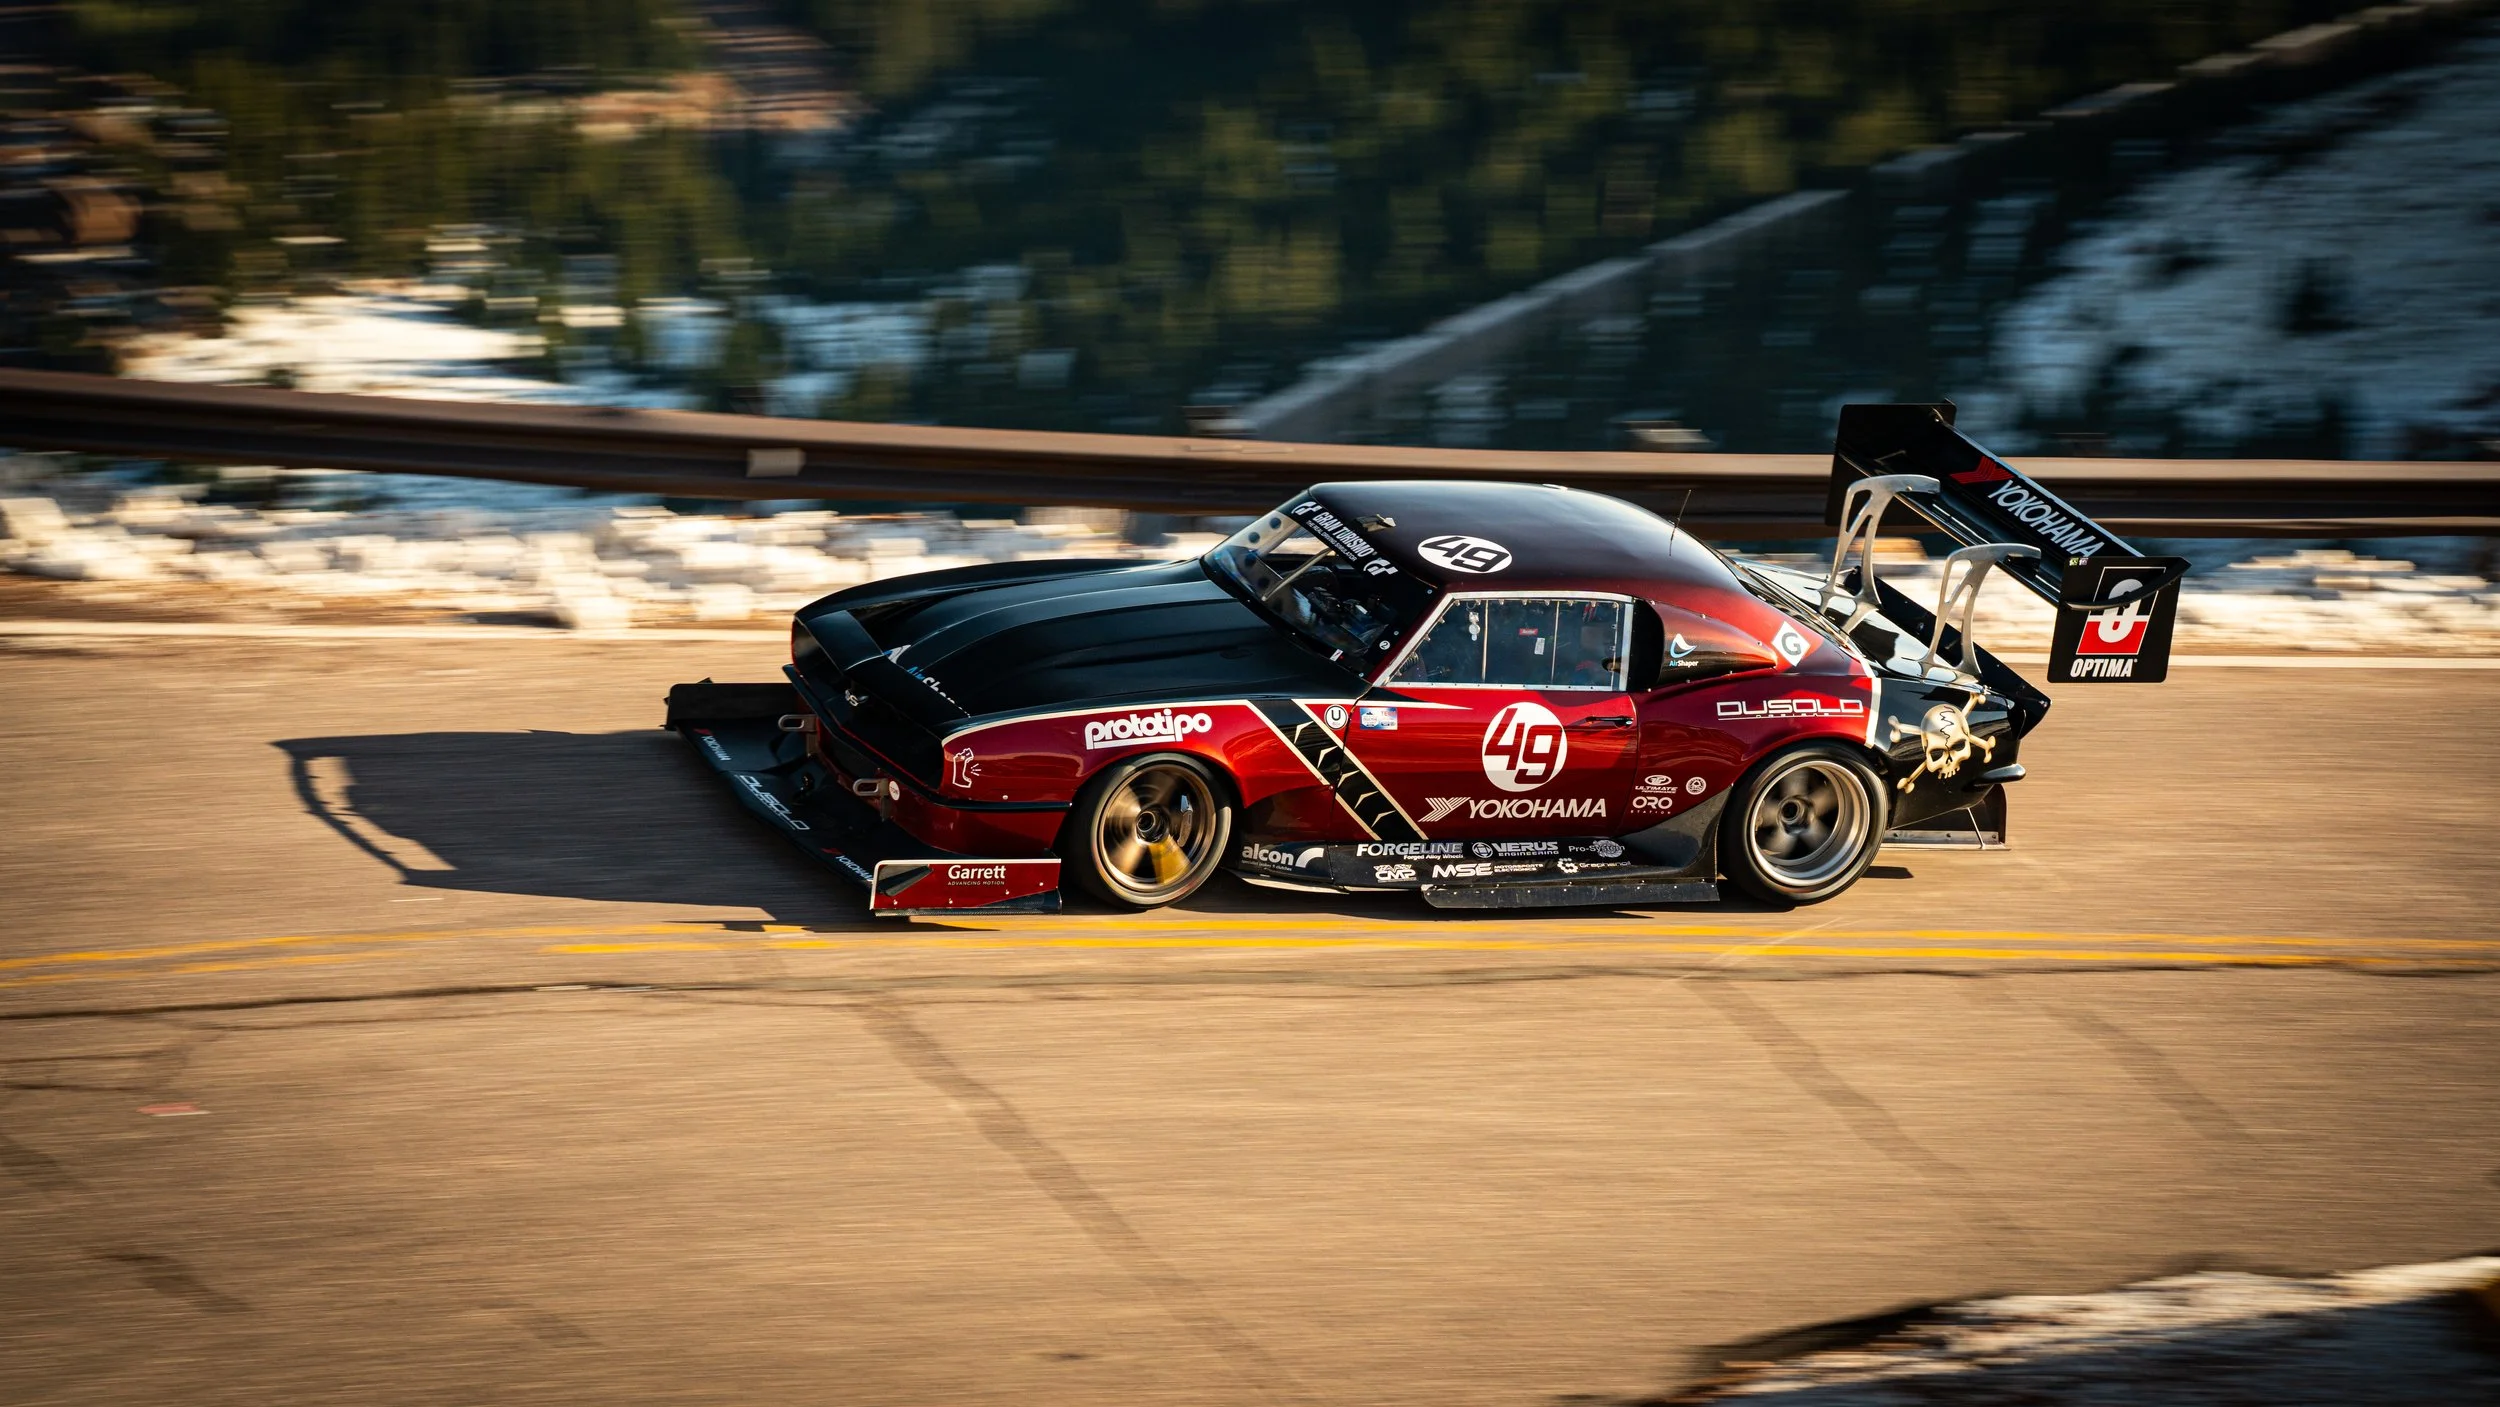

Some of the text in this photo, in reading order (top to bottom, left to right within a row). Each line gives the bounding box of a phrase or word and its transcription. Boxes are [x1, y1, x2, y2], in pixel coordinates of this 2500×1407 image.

[1988, 480, 2105, 557] YOKOHAMA
[1312, 511, 1375, 557] GRAN TURISMO
[1421, 536, 1510, 572] 49
[1781, 632, 1801, 656] G
[1669, 659, 1699, 668] AirShaper
[2070, 658, 2133, 678] OPTIMA
[1716, 699, 1864, 716] DUSOLD
[1084, 708, 1213, 751] prototipo
[1484, 708, 1563, 785] 49
[1469, 798, 1607, 819] YOKOHAMA
[1632, 796, 1673, 810] ORO
[1241, 843, 1295, 866] alcon
[1356, 842, 1464, 857] FORGELINE
[947, 864, 1007, 879] Garrett
[1432, 863, 1493, 878] MSE
